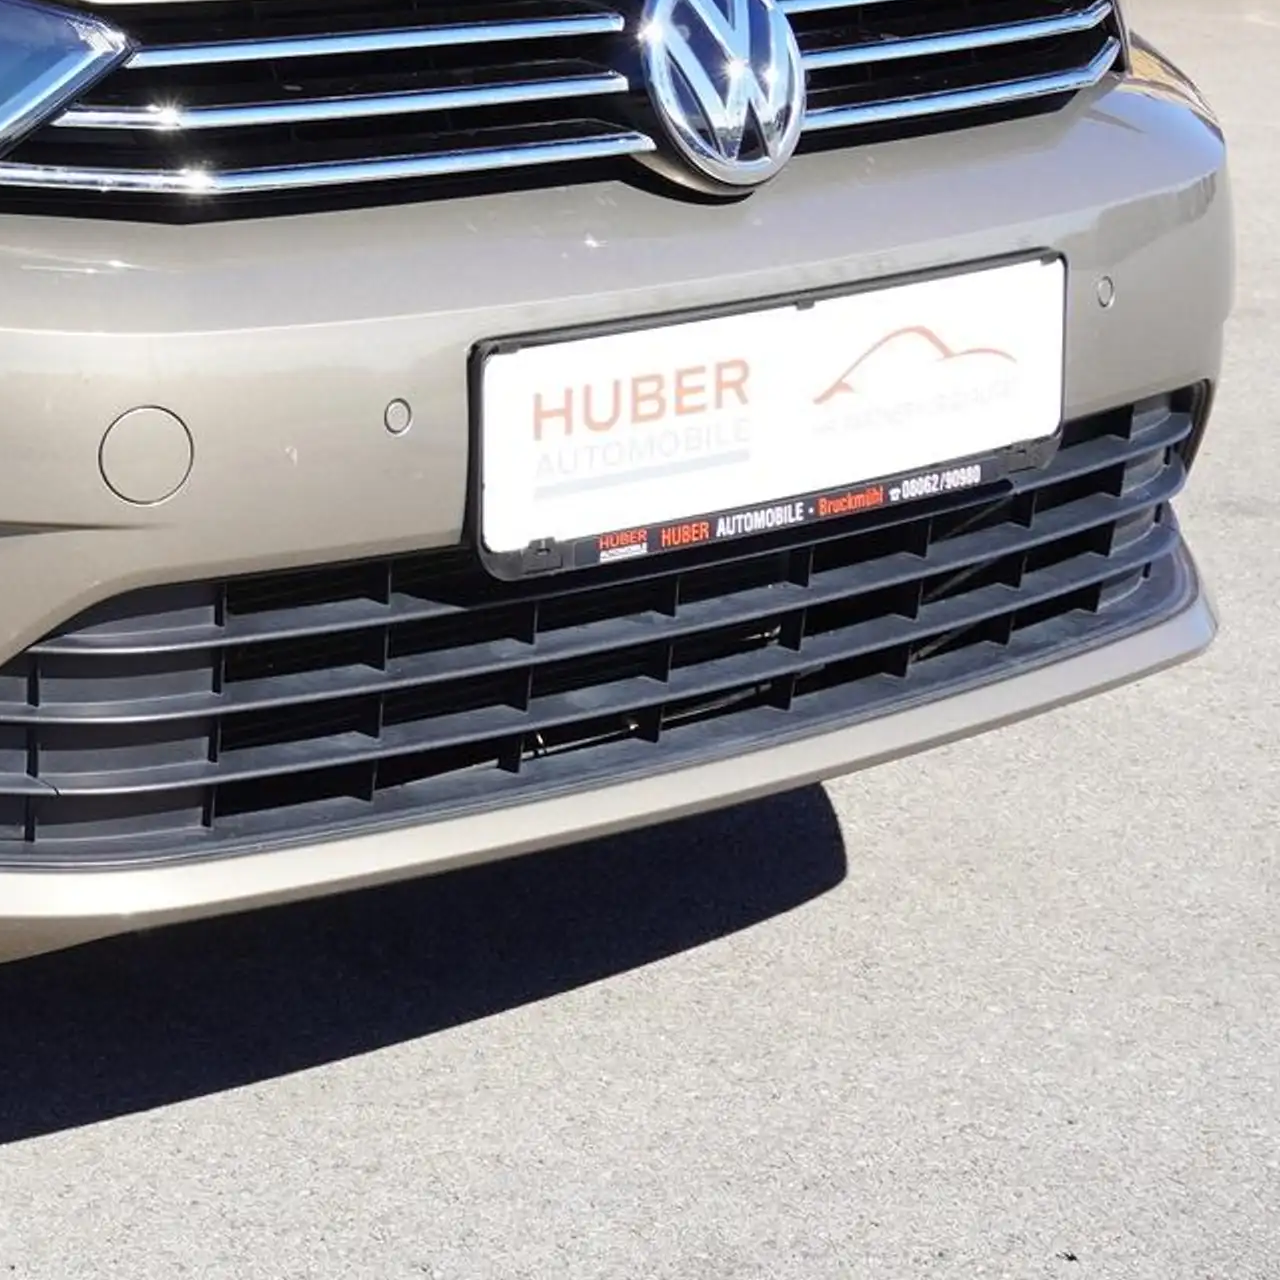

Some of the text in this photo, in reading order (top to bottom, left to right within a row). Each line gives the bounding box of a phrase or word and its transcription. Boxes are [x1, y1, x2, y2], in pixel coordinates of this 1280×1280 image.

[533, 358, 751, 441] HUBER
[538, 417, 751, 477] AUTOMOBILE
[599, 528, 648, 550] HUBER
[661, 521, 710, 548] HUBER
[716, 501, 805, 538] AUTOMOBILE
